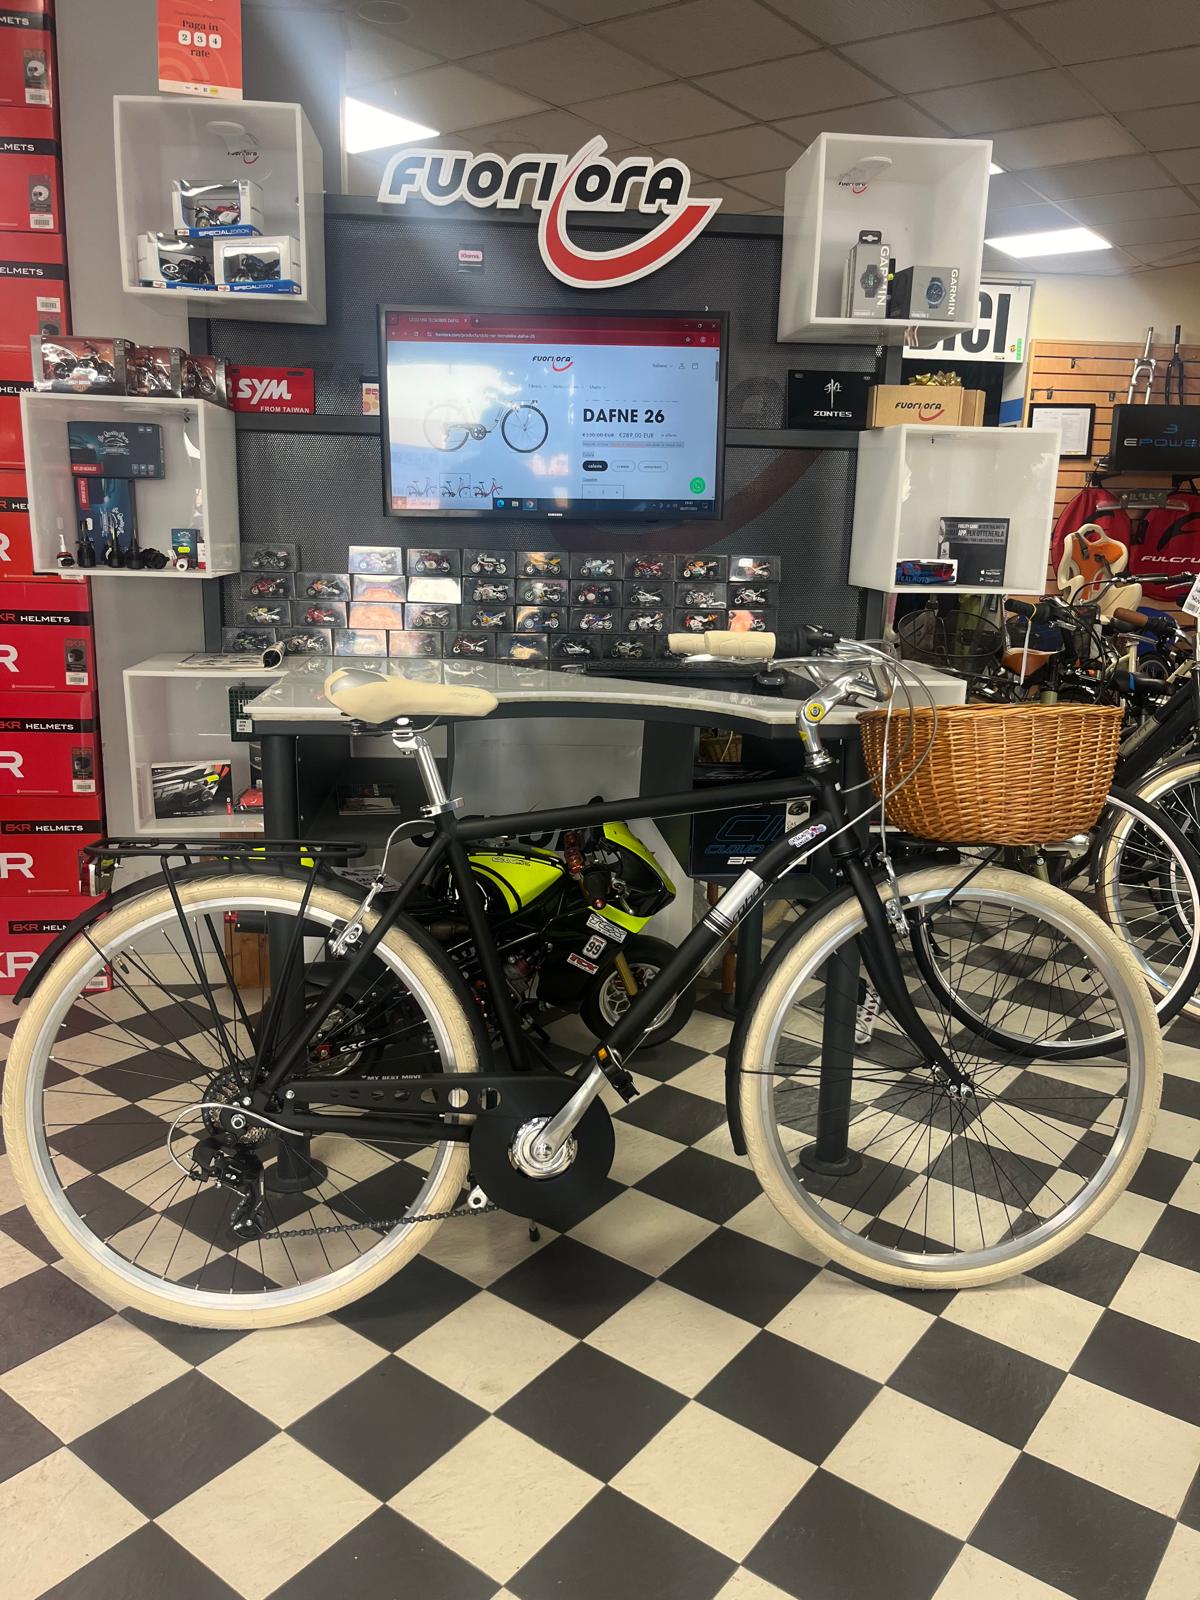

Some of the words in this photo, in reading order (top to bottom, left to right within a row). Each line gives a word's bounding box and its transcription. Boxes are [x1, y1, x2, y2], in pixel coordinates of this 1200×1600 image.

[182, 19, 206, 31] Paga
[208, 22, 219, 31] in
[197, 35, 203, 43] 3
[190, 49, 210, 57] rate
[947, 268, 959, 316] GARMIN
[236, 378, 293, 405] SYM
[260, 405, 281, 413] FROM
[281, 406, 310, 414] TAIWAN
[813, 410, 853, 418] ZONTES
[583, 408, 639, 423] DAFNE
[644, 409, 665, 424] 26
[20, 615, 71, 623] HELMETS
[25, 723, 74, 731] HELMETS
[586, 941, 602, 956] 99
